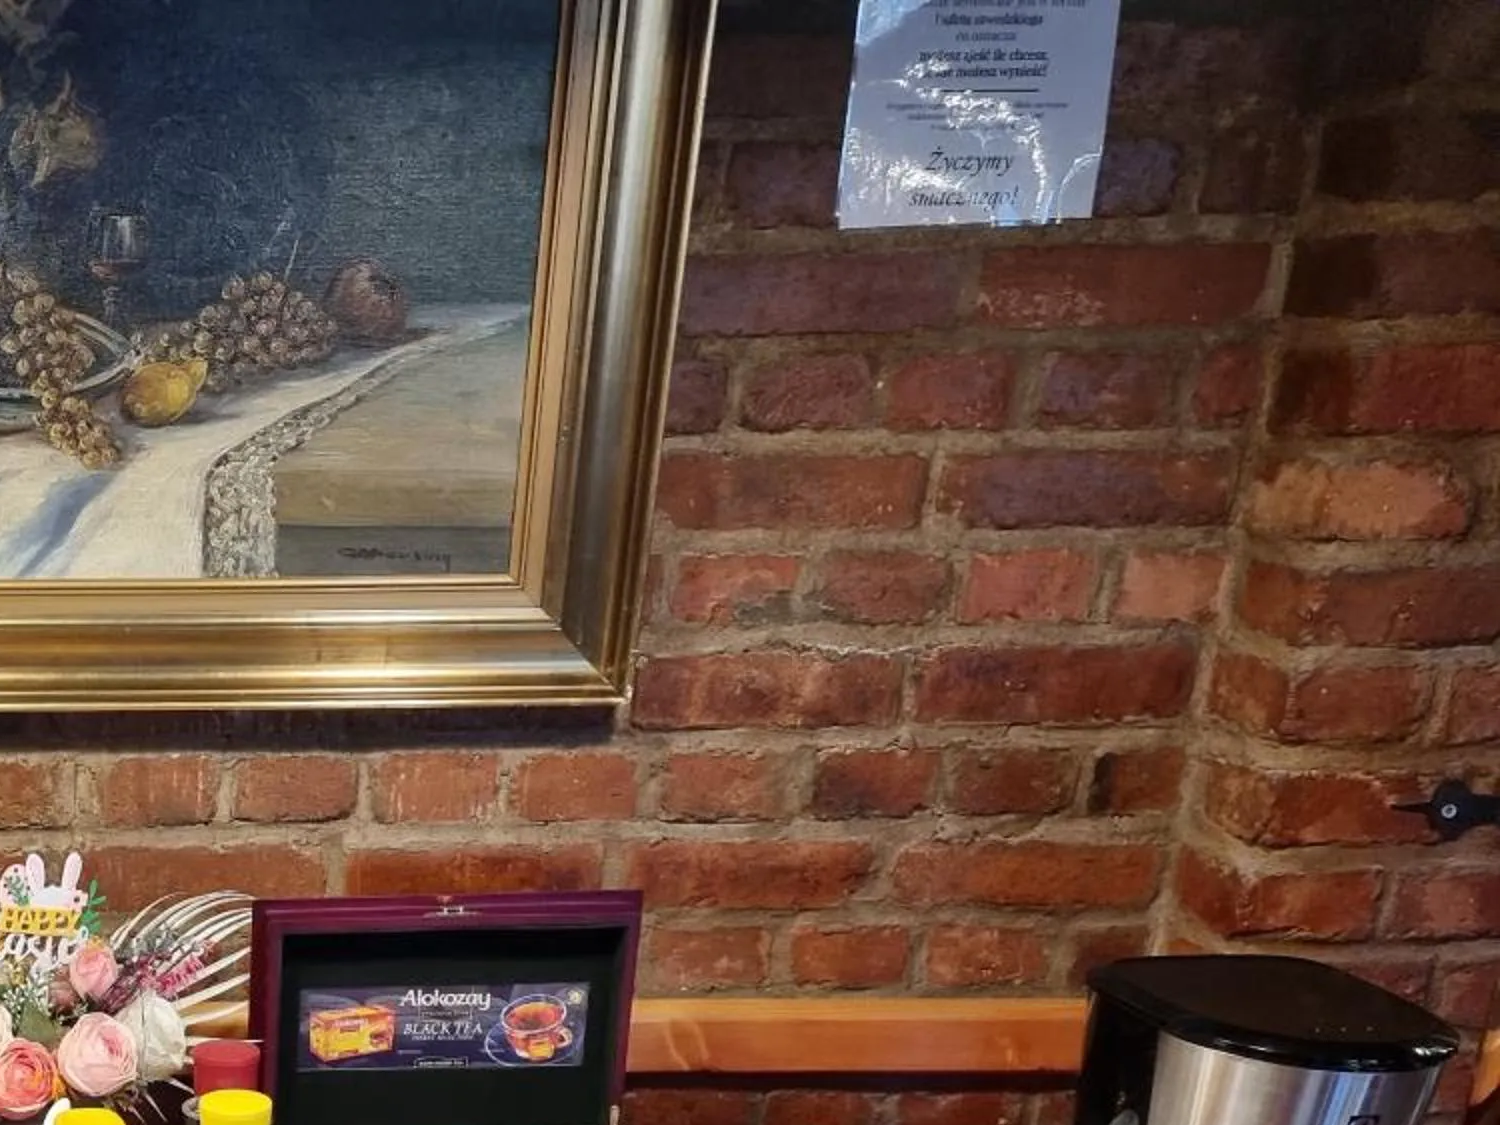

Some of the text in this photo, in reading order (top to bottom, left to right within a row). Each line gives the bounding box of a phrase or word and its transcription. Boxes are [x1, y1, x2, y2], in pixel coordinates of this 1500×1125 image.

[923, 146, 1016, 177] Życzymy
[398, 988, 492, 1011] Alokozay
[403, 1021, 483, 1036] BLACK TEA
